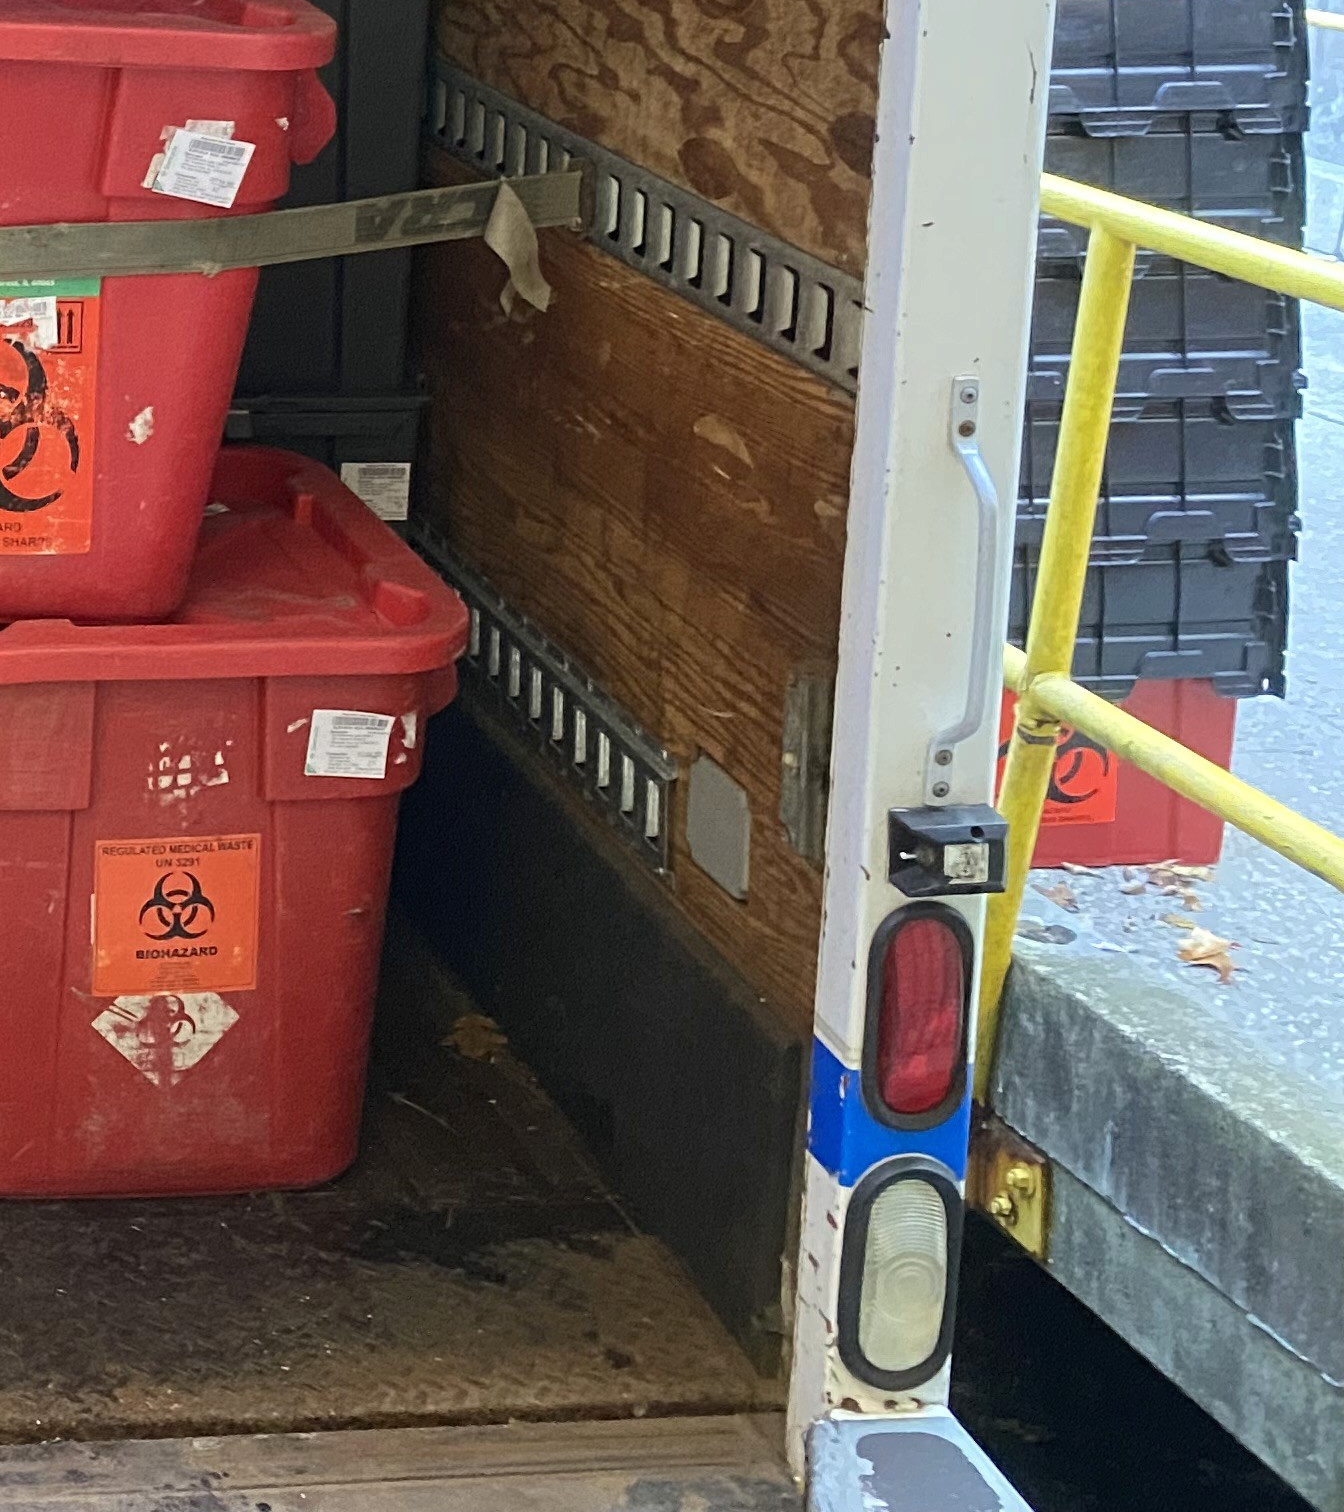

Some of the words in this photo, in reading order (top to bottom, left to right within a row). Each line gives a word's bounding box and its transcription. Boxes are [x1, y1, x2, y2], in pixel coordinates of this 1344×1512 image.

[102, 844, 166, 857] REGULATED
[169, 842, 216, 855] MEDICAL
[217, 840, 254, 852] WASTE
[156, 857, 173, 868] UN
[176, 856, 201, 868] 3291
[135, 945, 219, 960] BIOHAZARD
